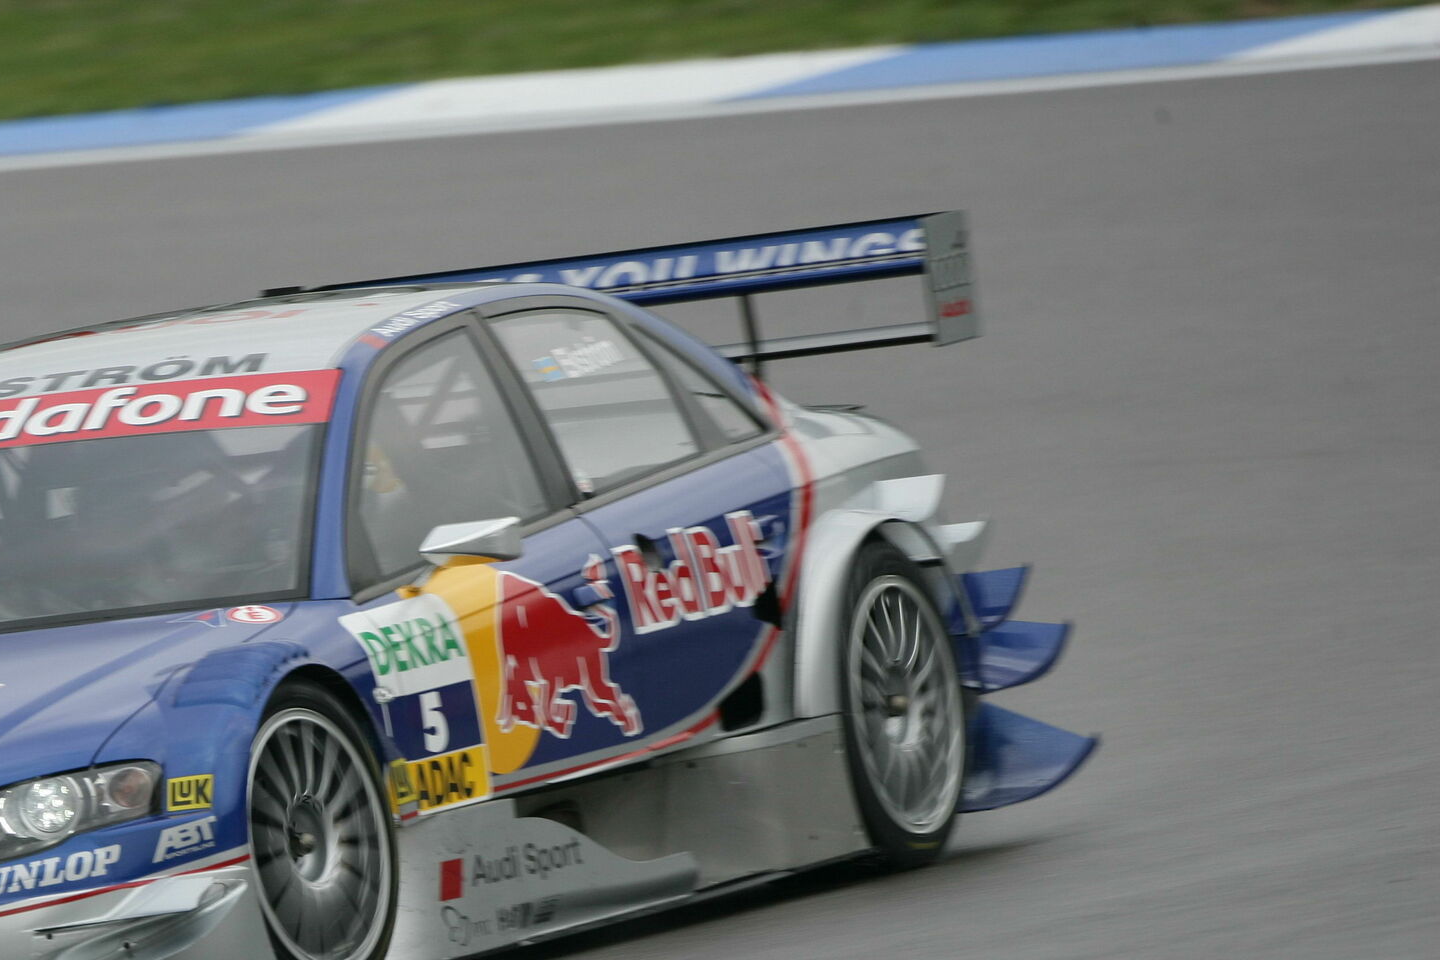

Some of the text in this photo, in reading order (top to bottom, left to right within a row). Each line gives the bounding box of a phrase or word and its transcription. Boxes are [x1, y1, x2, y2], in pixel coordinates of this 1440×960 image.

[611, 527, 701, 634] Red
[360, 612, 465, 677] DEKRA
[418, 692, 450, 753] 5
[417, 752, 475, 806] ADAC
[152, 815, 216, 863] ABT
[472, 837, 583, 887] Audi Sport
